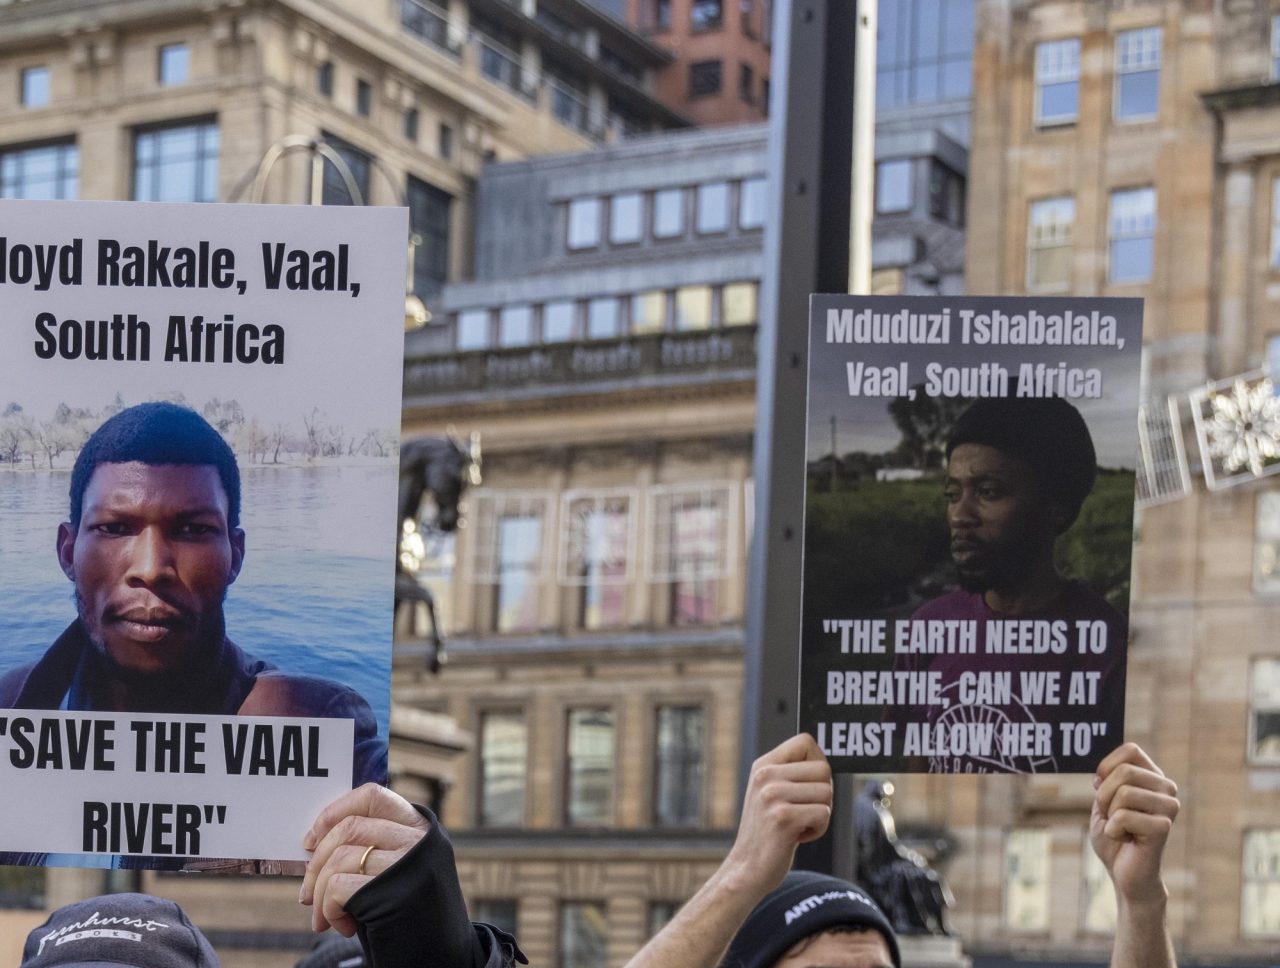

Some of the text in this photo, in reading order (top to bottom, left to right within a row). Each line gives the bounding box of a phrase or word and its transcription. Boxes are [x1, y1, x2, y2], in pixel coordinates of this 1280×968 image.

[96, 238, 248, 295] Rakale,
[261, 242, 361, 298] Vaal,
[34, 312, 286, 364] South Africa
[826, 308, 1125, 349] Mduduzi Tshabalala,
[846, 362, 1102, 401] Vaal, South Africa
[822, 619, 1108, 654] "THE EARTH NEEDS TO
[826, 671, 1101, 709] BREATHE, CAN WE AT
[130, 720, 206, 774] THE
[221, 722, 329, 778] VAAL
[817, 722, 1108, 757] LEAST ALLOW HER TO"
[81, 801, 227, 855] RIVER"
